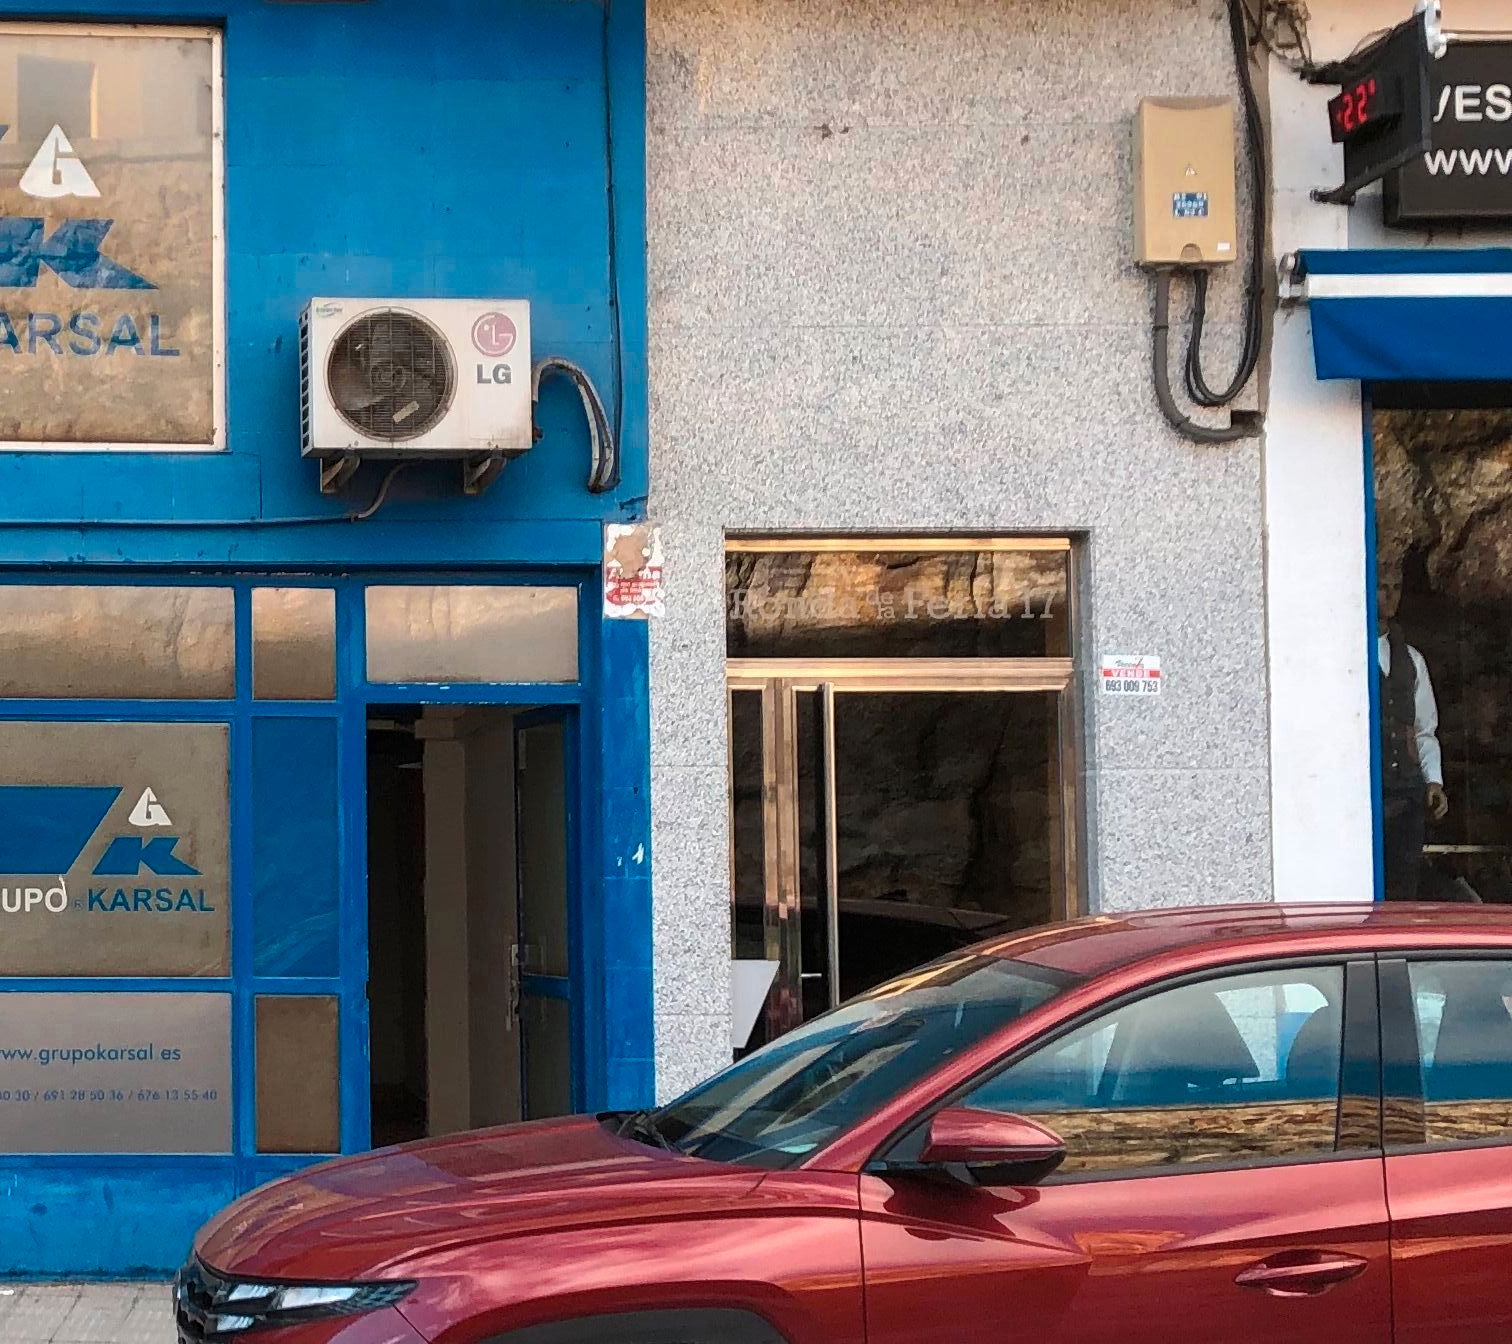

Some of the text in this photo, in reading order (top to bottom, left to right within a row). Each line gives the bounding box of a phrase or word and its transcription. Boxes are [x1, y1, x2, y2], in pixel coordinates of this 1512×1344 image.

[476, 363, 512, 384] LG
[728, 587, 861, 620] Ronda
[902, 586, 1011, 620] Feria
[1021, 590, 1055, 620] 17
[88, 887, 216, 913] KARSAL
[90, 1089, 105, 1101] 50
[183, 1089, 198, 1101] 55
[202, 1089, 217, 1101] 40
